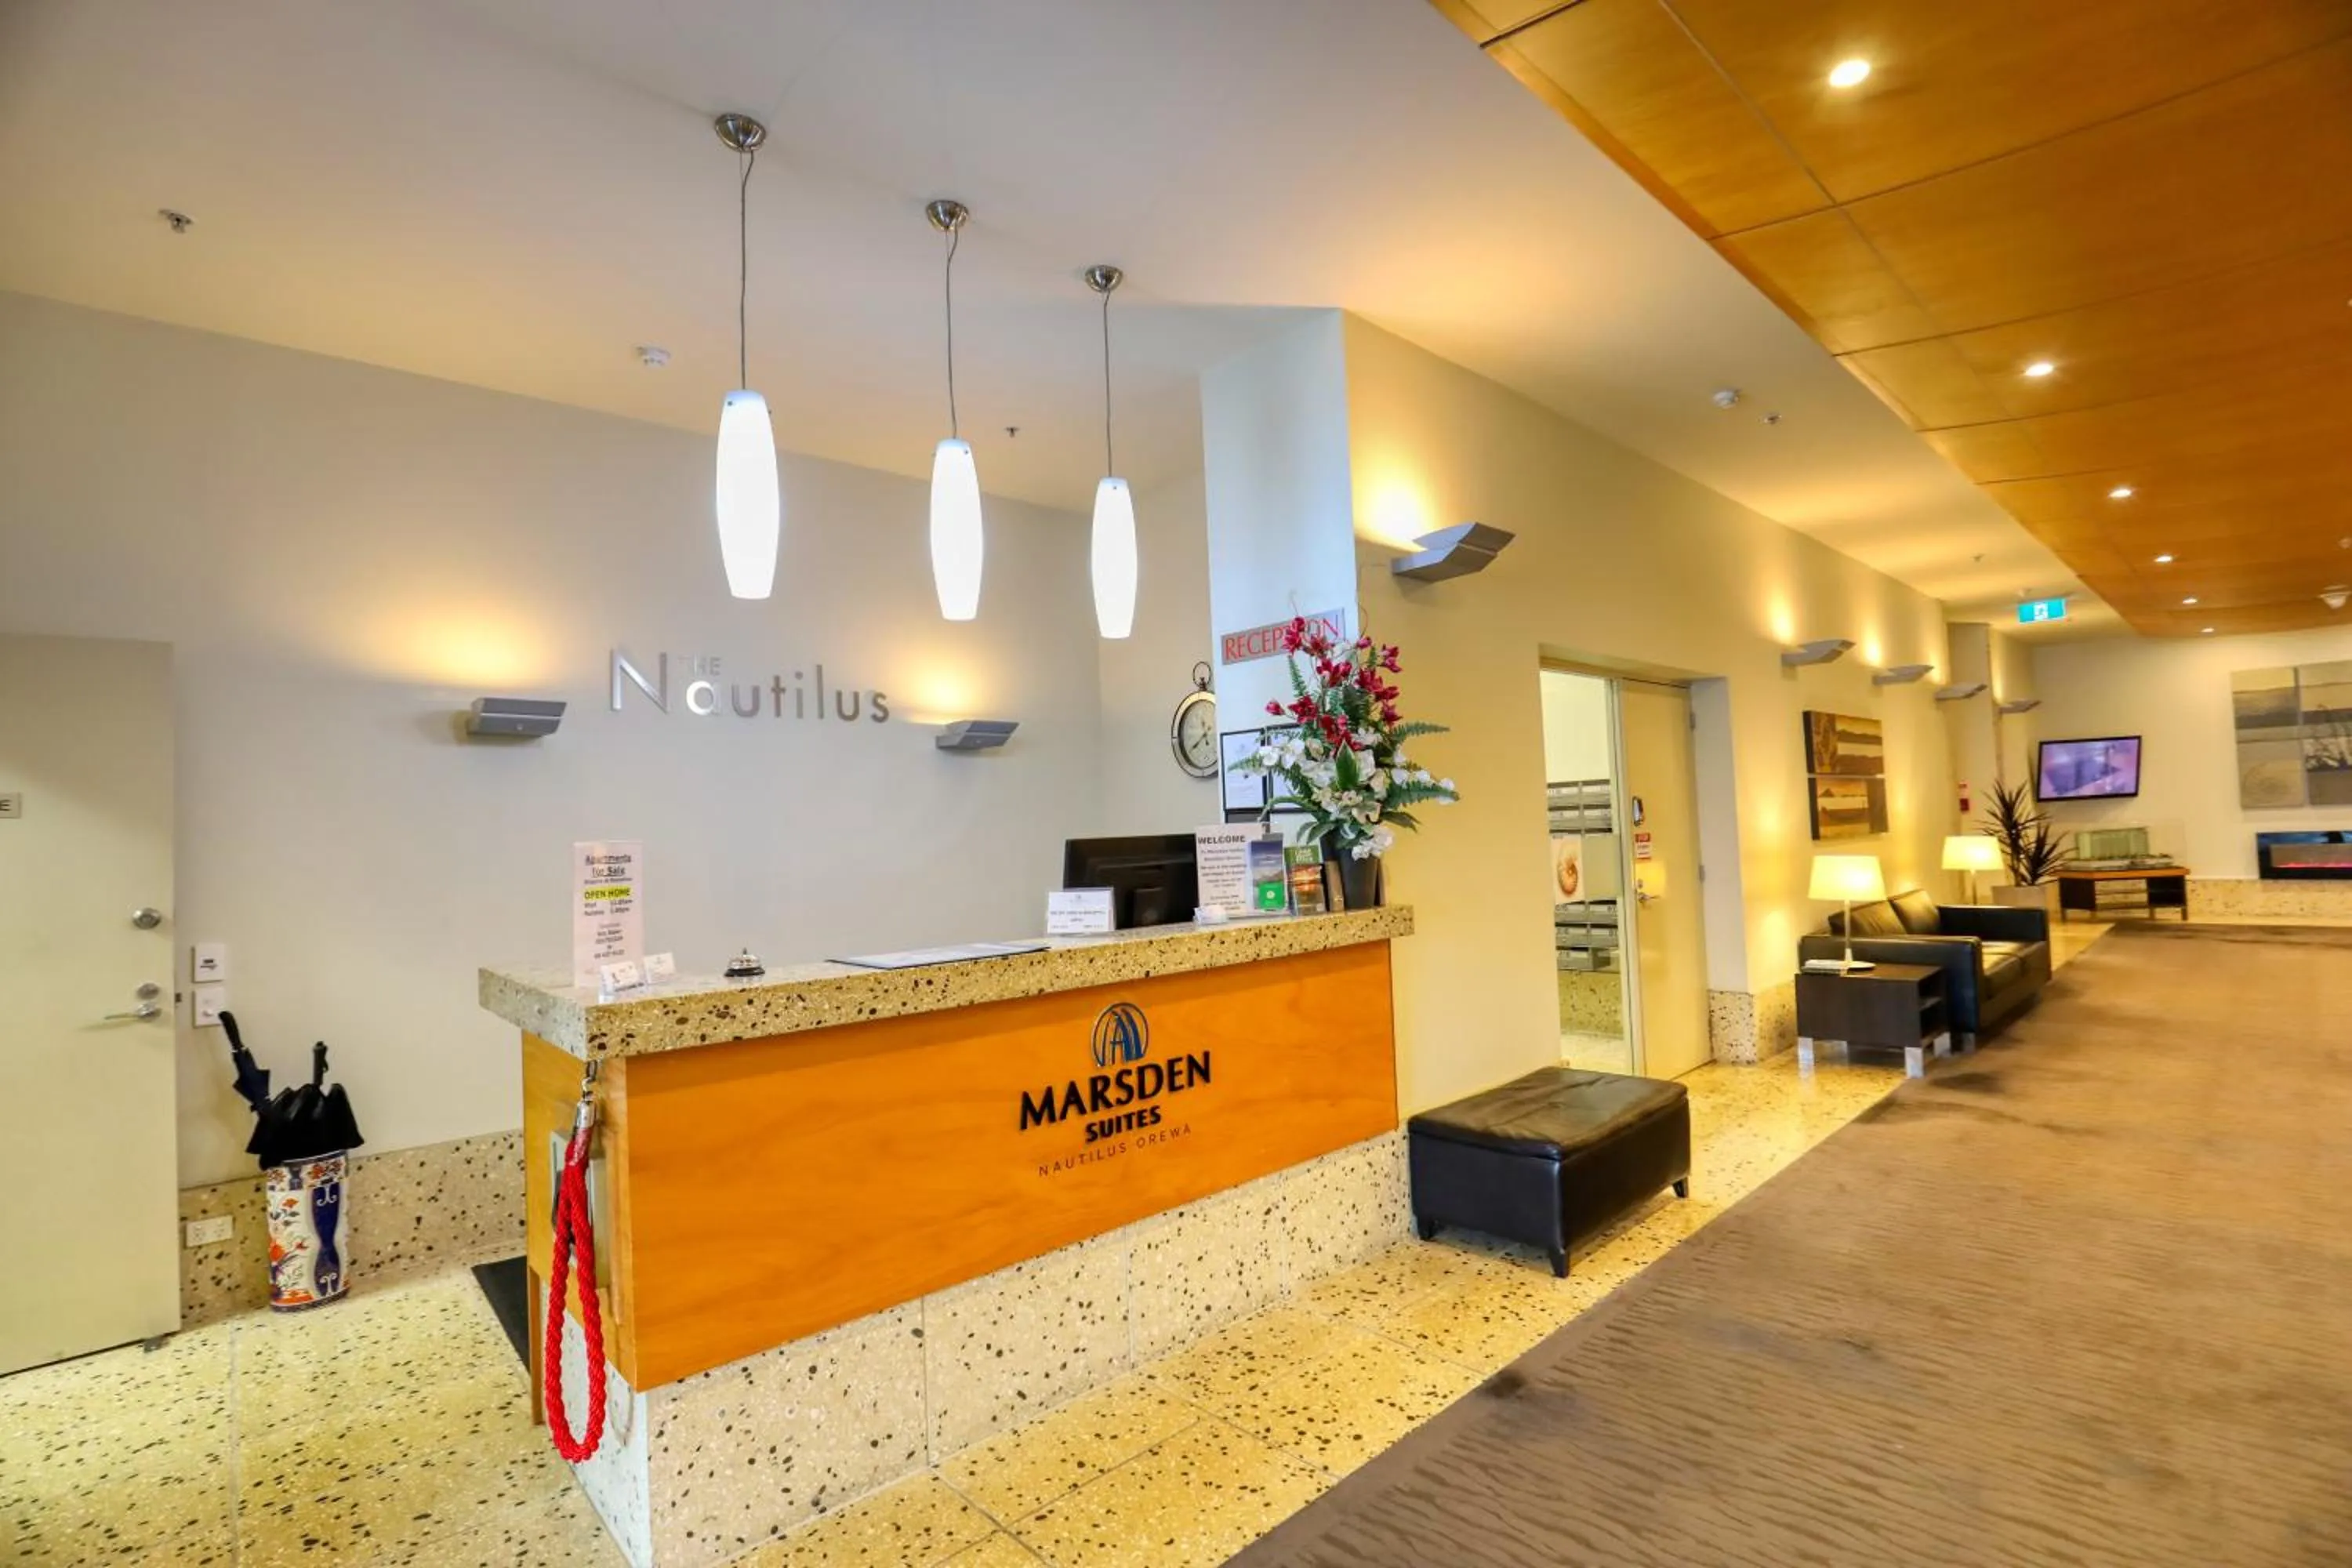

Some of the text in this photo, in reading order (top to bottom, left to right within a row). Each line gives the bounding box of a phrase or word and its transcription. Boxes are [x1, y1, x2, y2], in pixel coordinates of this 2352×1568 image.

[1225, 615, 1338, 660] RECEPON
[677, 655, 722, 677] THE
[609, 648, 891, 724] Nautilus
[1198, 835, 1246, 844] WELCOME
[608, 866, 626, 876] Sale
[585, 887, 631, 899] OPEN HOME
[1019, 1050, 1211, 1131] MARSDEN
[1085, 1105, 1162, 1144] SUITES
[1039, 1123, 1192, 1178] NAUTILUS OREWA
